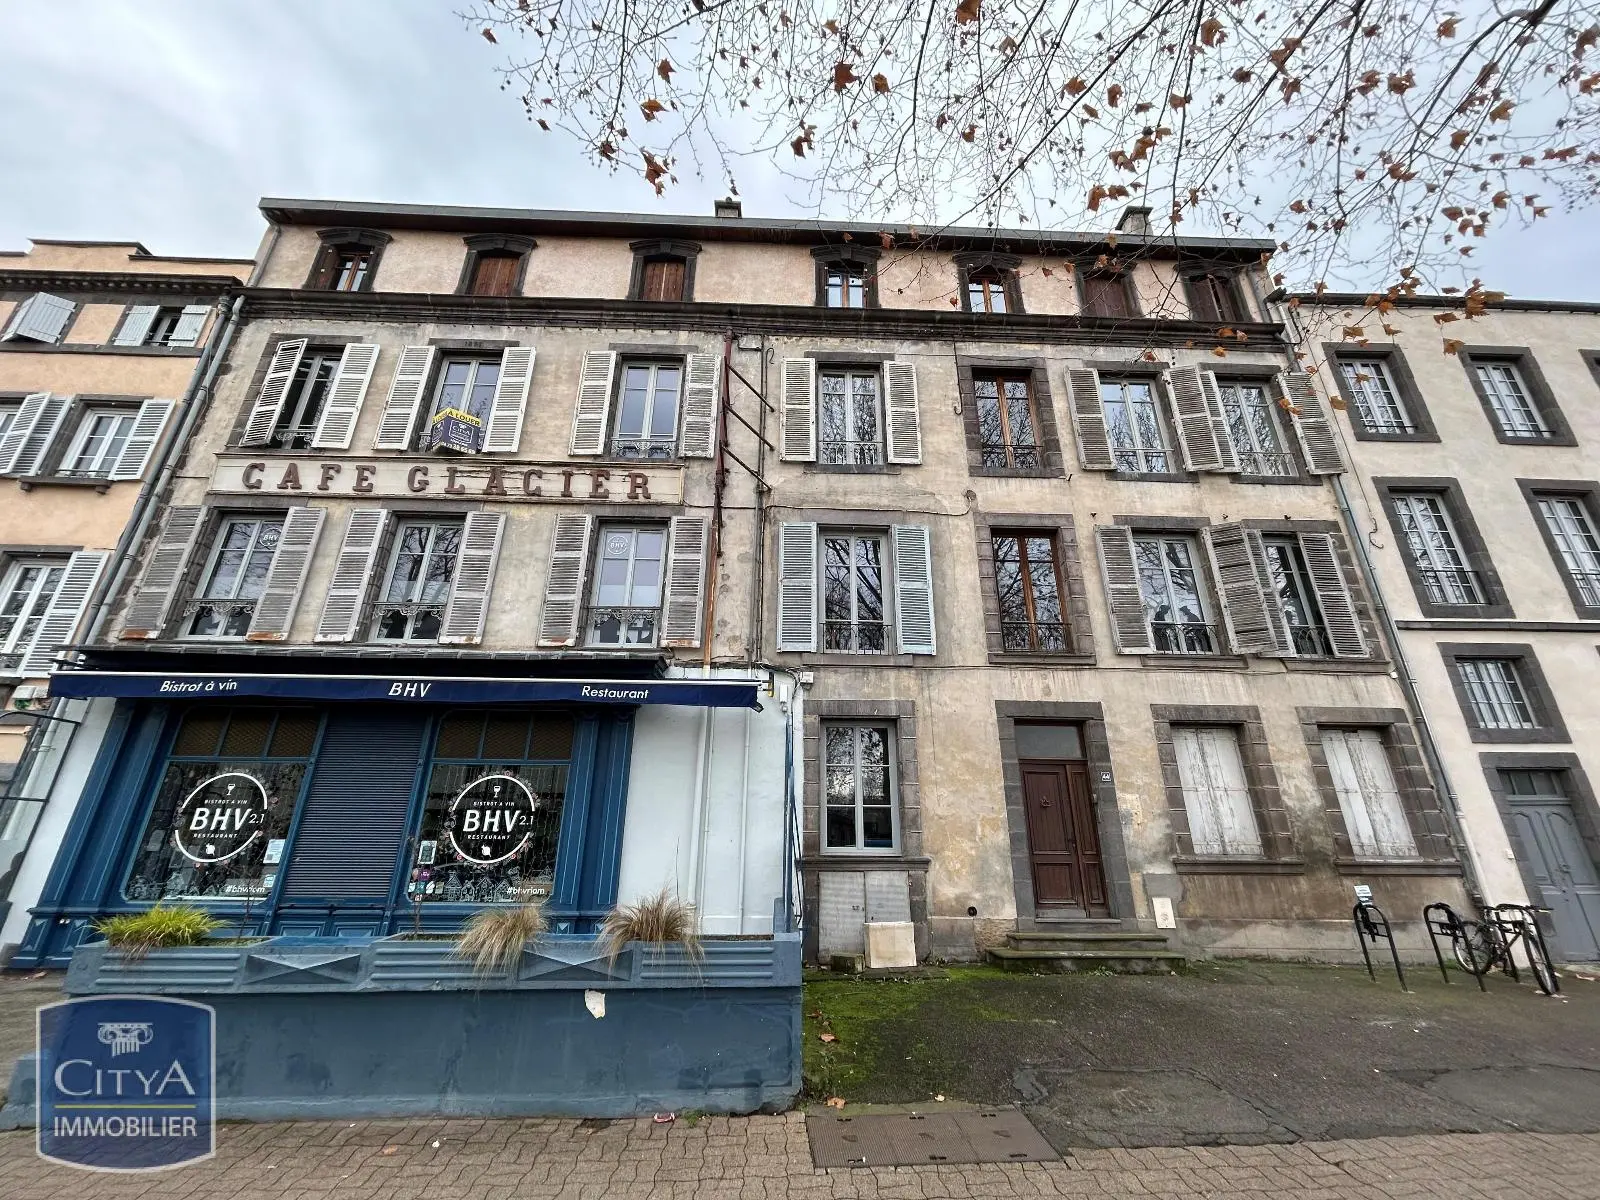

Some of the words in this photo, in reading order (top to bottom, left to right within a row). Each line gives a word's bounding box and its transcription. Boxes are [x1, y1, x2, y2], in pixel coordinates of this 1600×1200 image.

[456, 413, 480, 426] LOUER
[242, 462, 376, 492] CAFE
[407, 465, 651, 499] GLACIER
[160, 680, 203, 692] Bistrot
[205, 681, 215, 691] à
[219, 679, 238, 691] vin
[388, 682, 432, 697] BHV
[581, 685, 649, 698] Restaurant
[189, 807, 252, 831] BHV
[248, 813, 265, 824] 2.1
[462, 809, 521, 832] BHV
[518, 815, 534, 825] 2.1
